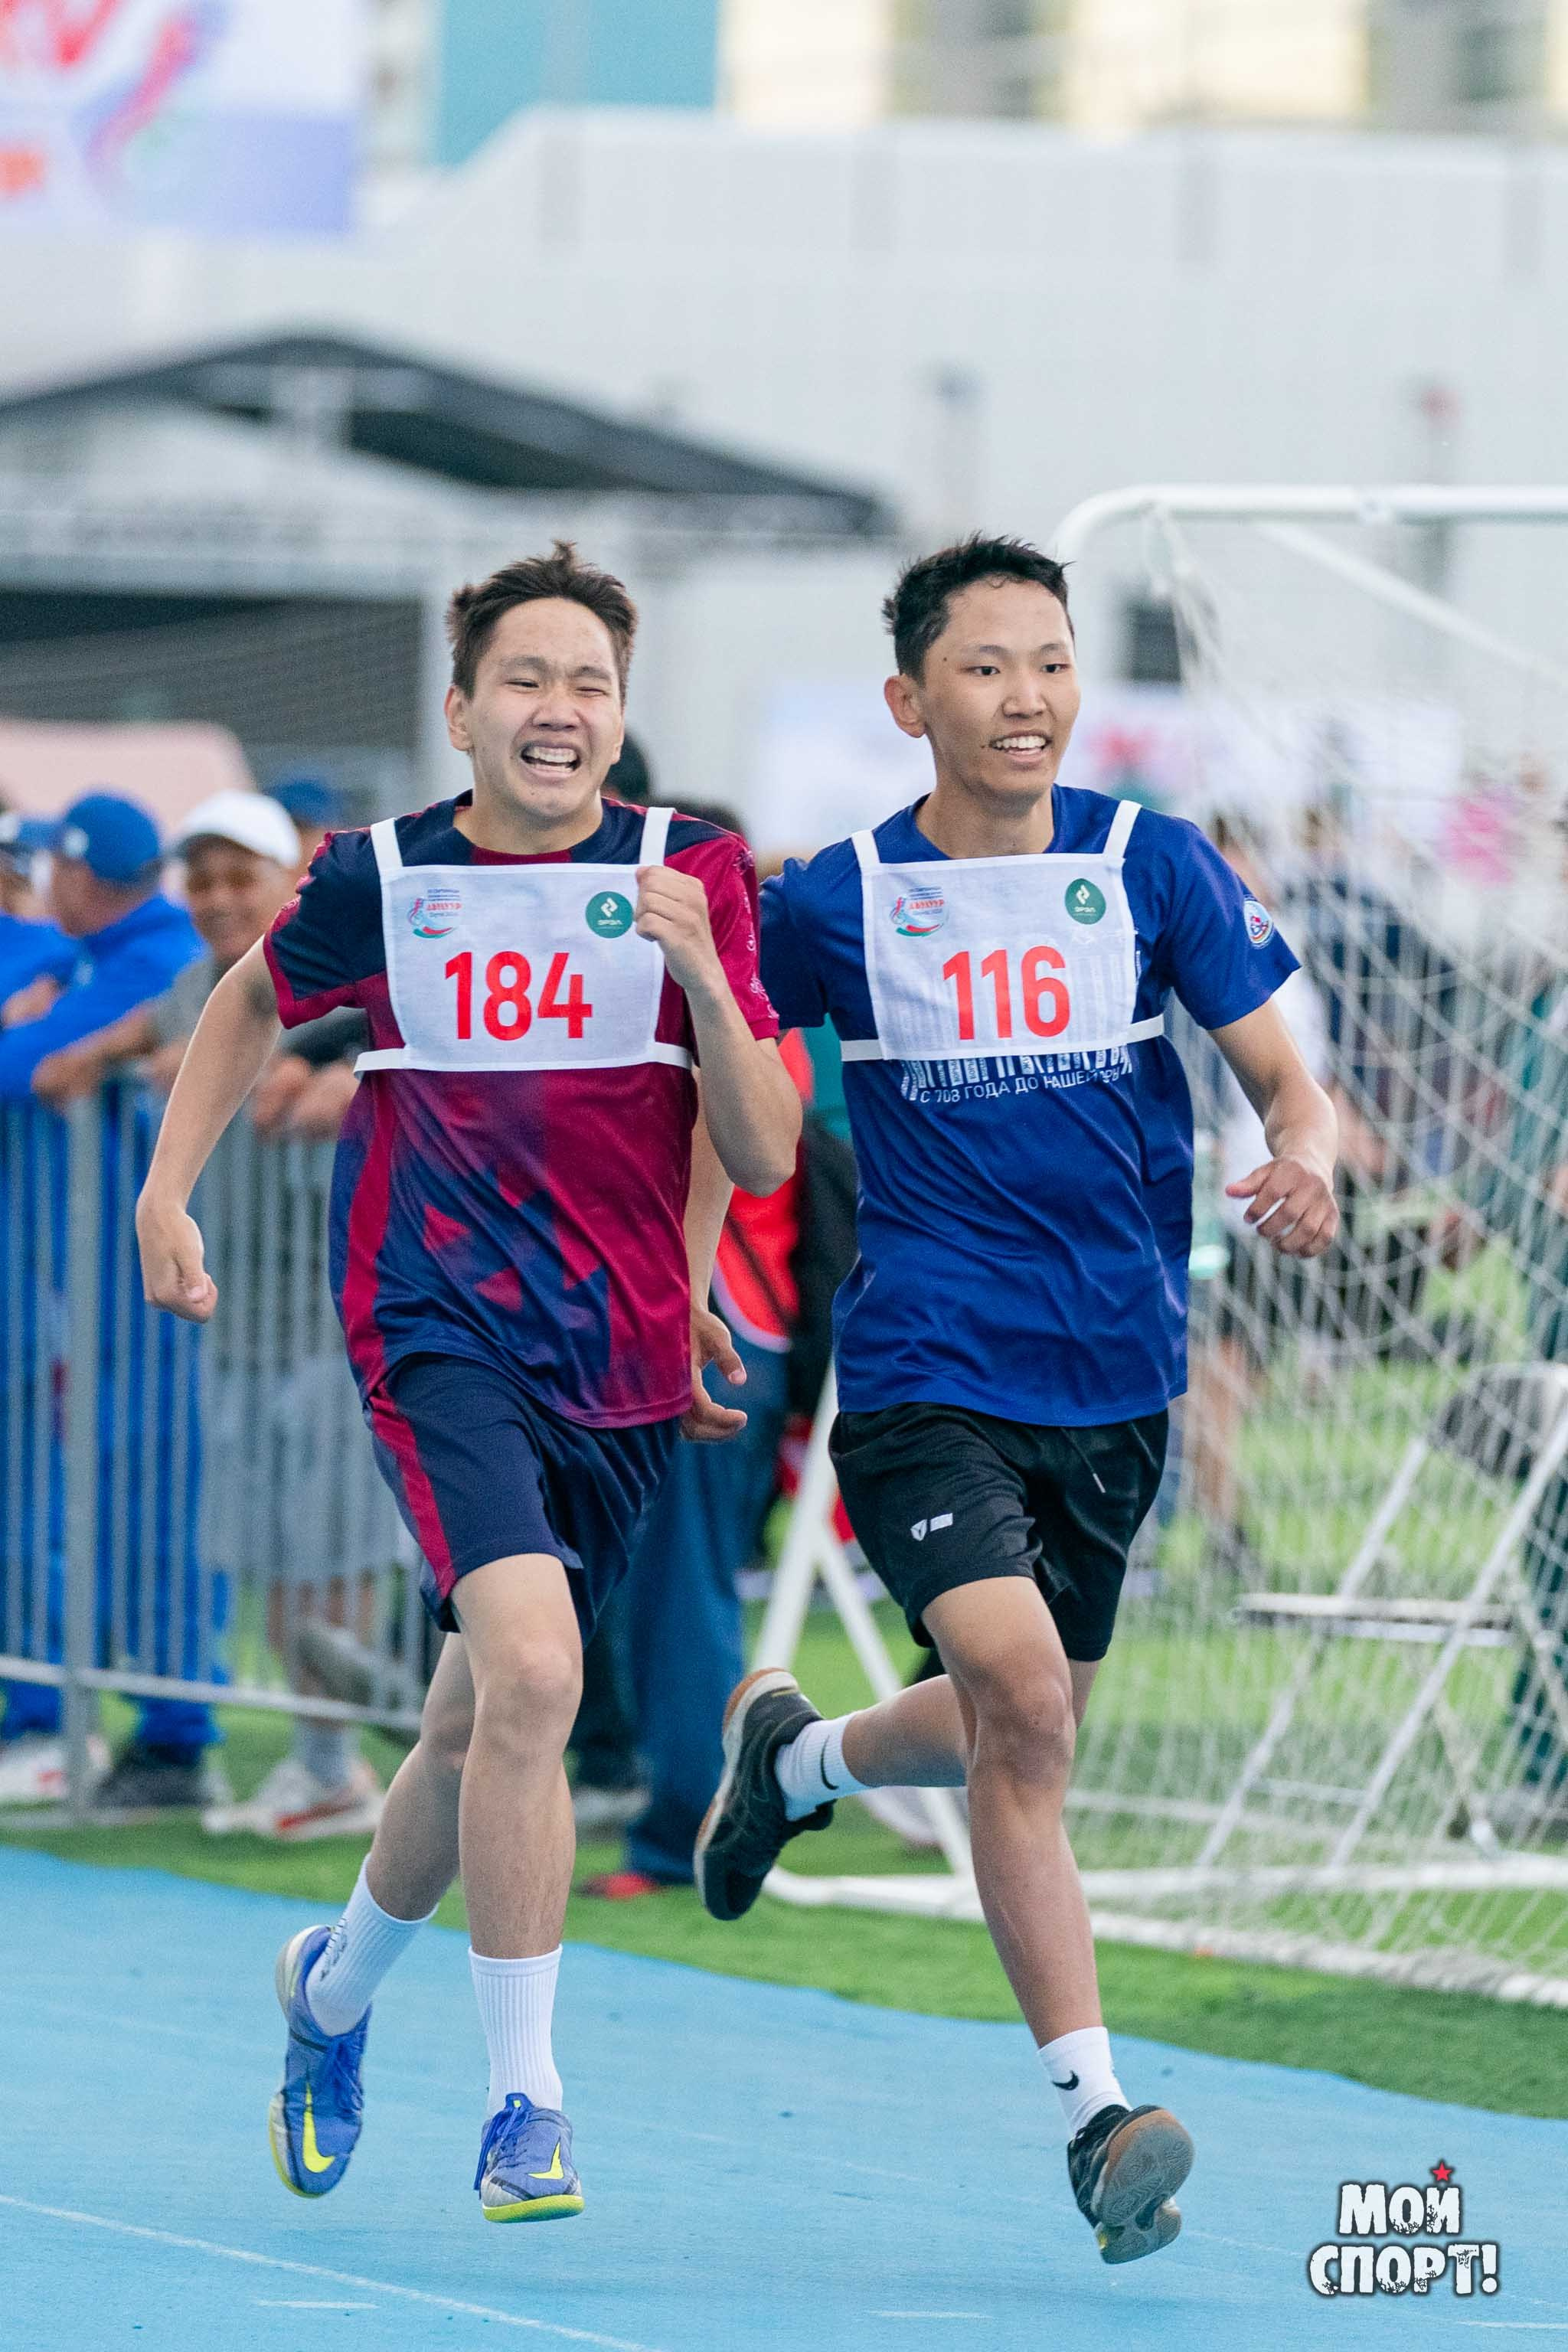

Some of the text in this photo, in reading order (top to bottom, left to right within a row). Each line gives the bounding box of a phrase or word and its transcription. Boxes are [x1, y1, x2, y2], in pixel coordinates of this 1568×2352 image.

[445, 951, 592, 1041] 184
[942, 946, 1071, 1040] 116
[920, 1090, 931, 1103] С
[934, 1089, 961, 1103] 708
[964, 1080, 1011, 1100] ГОДА
[1014, 1076, 1039, 1095] ДО
